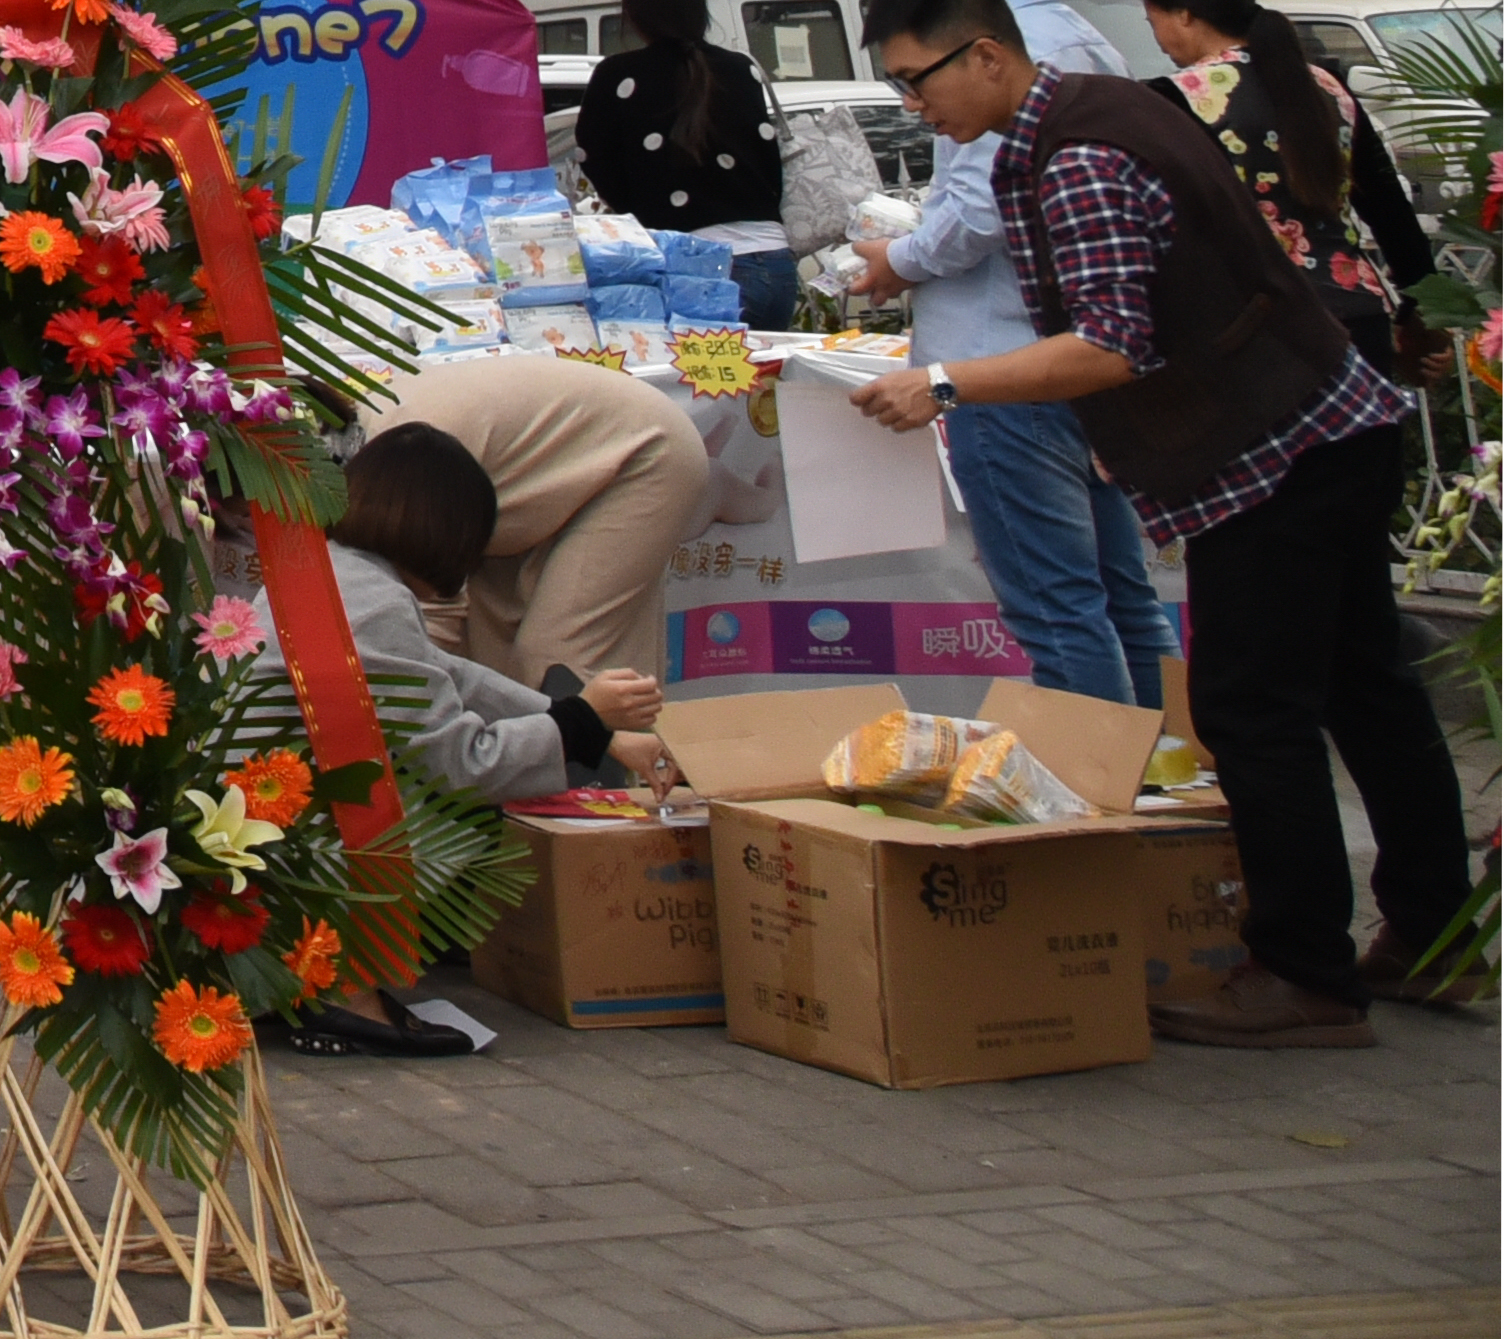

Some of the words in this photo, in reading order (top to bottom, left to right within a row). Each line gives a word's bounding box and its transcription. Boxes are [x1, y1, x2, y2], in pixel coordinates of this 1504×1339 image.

[928, 868, 1008, 913] Sing
[634, 896, 715, 923] Wibb
[949, 903, 997, 928] me
